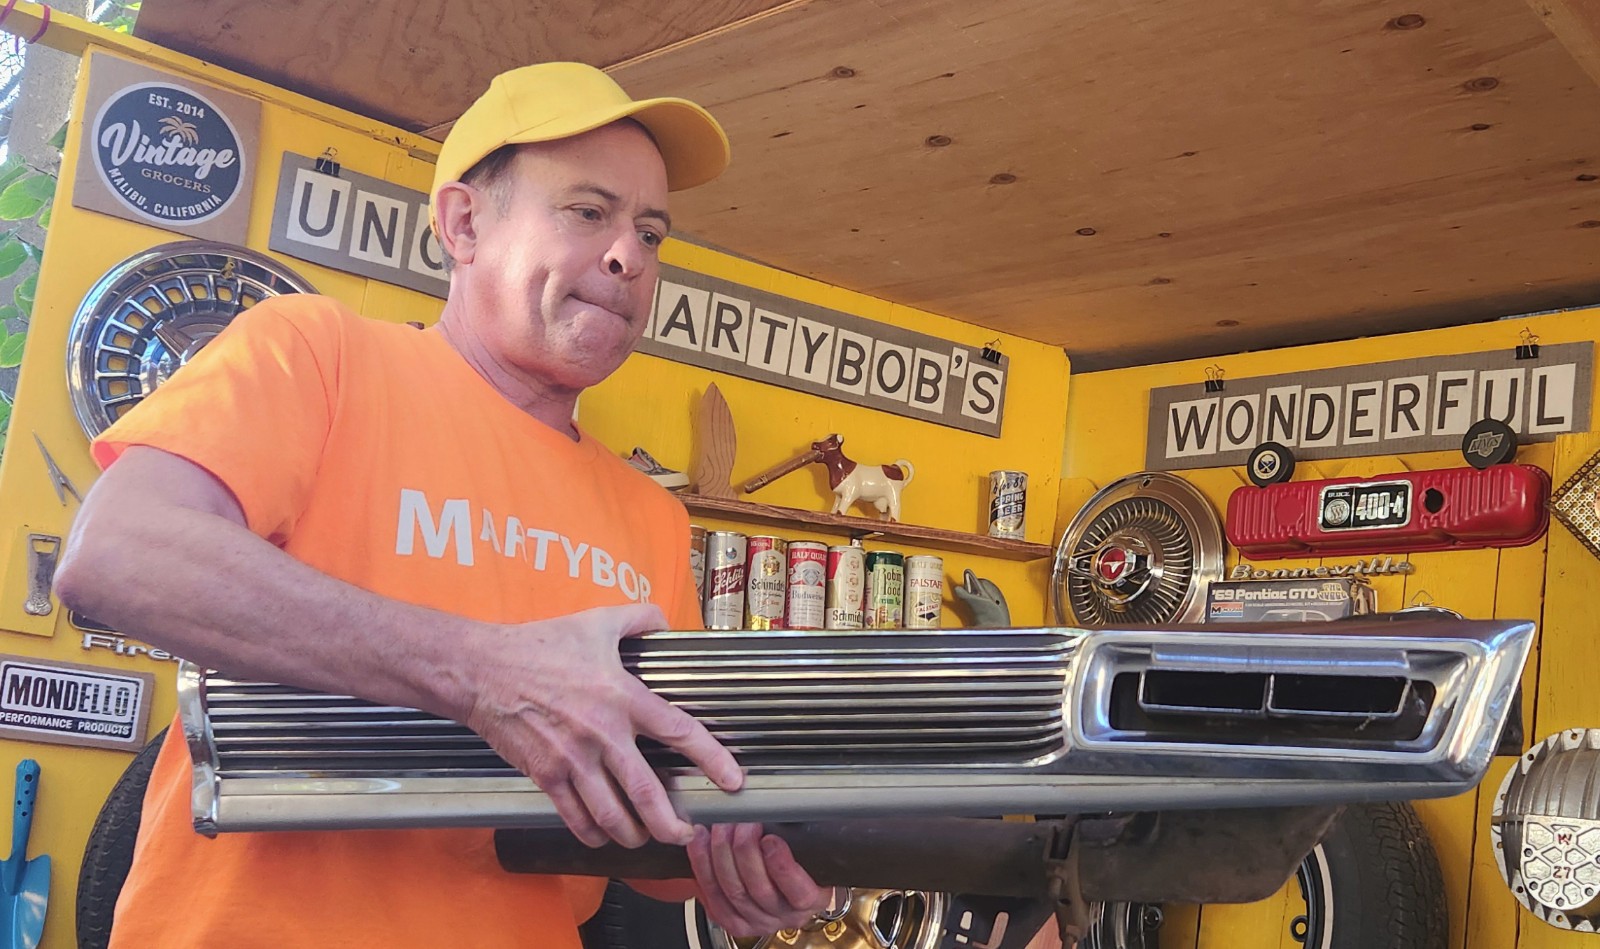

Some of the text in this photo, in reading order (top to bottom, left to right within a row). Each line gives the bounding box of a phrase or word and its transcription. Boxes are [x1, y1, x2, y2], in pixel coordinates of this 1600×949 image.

[149, 94, 204, 118] EST. 2014
[101, 120, 236, 179] Vintage
[108, 168, 222, 217] MALIBU, CALIFORNIA
[141, 168, 211, 193] GROCERS
[660, 294, 999, 414] ARTYBOB'S
[1171, 374, 1565, 452] WONDERFUL
[997, 504, 1023, 517] BEER
[1355, 491, 1405, 521] 400-4
[1230, 556, 1416, 579] Bonneville
[1235, 587, 1288, 600] Pontiac
[1289, 587, 1318, 600] GTO
[7, 674, 130, 717] MONDELLO
[0, 711, 131, 736] PERFORMANCE PRODUCTS
[1553, 865, 1571, 879] 27
